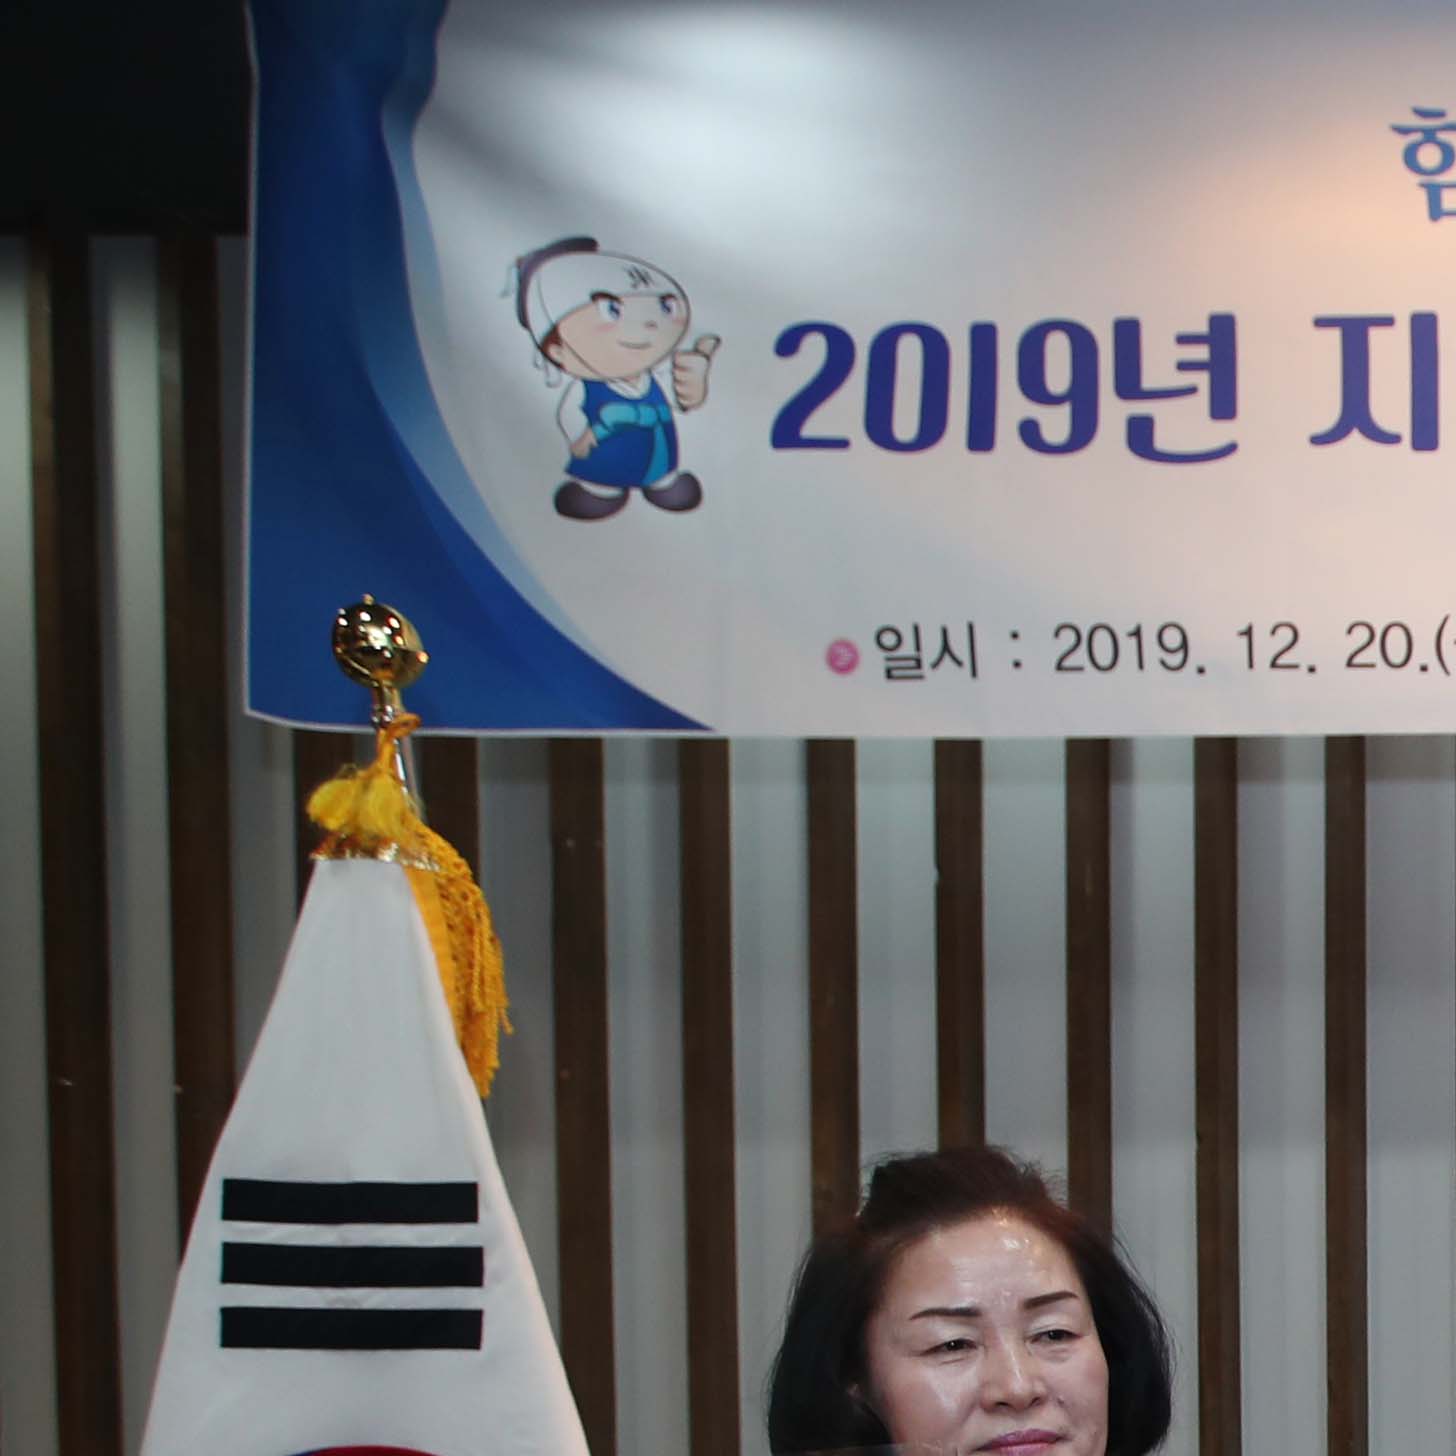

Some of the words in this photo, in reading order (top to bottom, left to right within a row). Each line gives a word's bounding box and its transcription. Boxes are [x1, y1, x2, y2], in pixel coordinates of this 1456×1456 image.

[770, 315, 1237, 463] 2019년
[876, 623, 976, 680] 일시
[1054, 624, 1205, 674] 2019.
[1239, 623, 1316, 673] 12.
